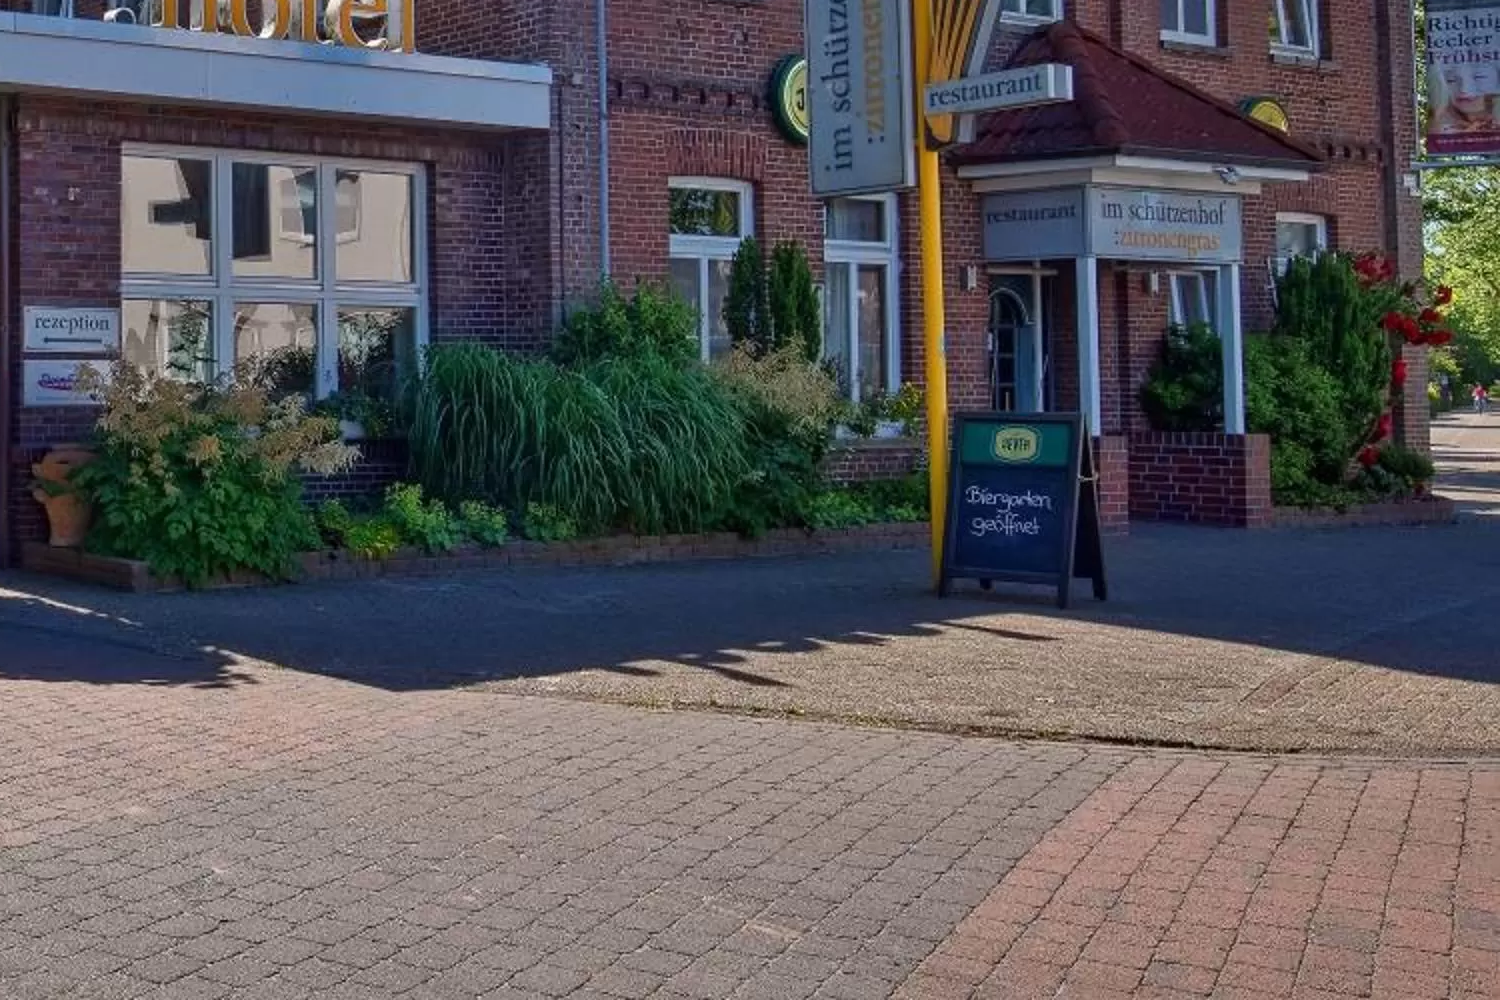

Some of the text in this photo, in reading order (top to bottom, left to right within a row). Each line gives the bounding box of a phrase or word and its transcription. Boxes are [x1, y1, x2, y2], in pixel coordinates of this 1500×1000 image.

[1427, 32, 1493, 49] lecker
[929, 72, 1043, 107] restaurant
[824, 124, 852, 173] im
[987, 204, 1076, 225] restaurant
[1101, 193, 1226, 226] im schützenhof
[35, 315, 110, 335] rezeption
[966, 485, 1052, 512] Biergarten
[970, 512, 1040, 537] geöffnet
